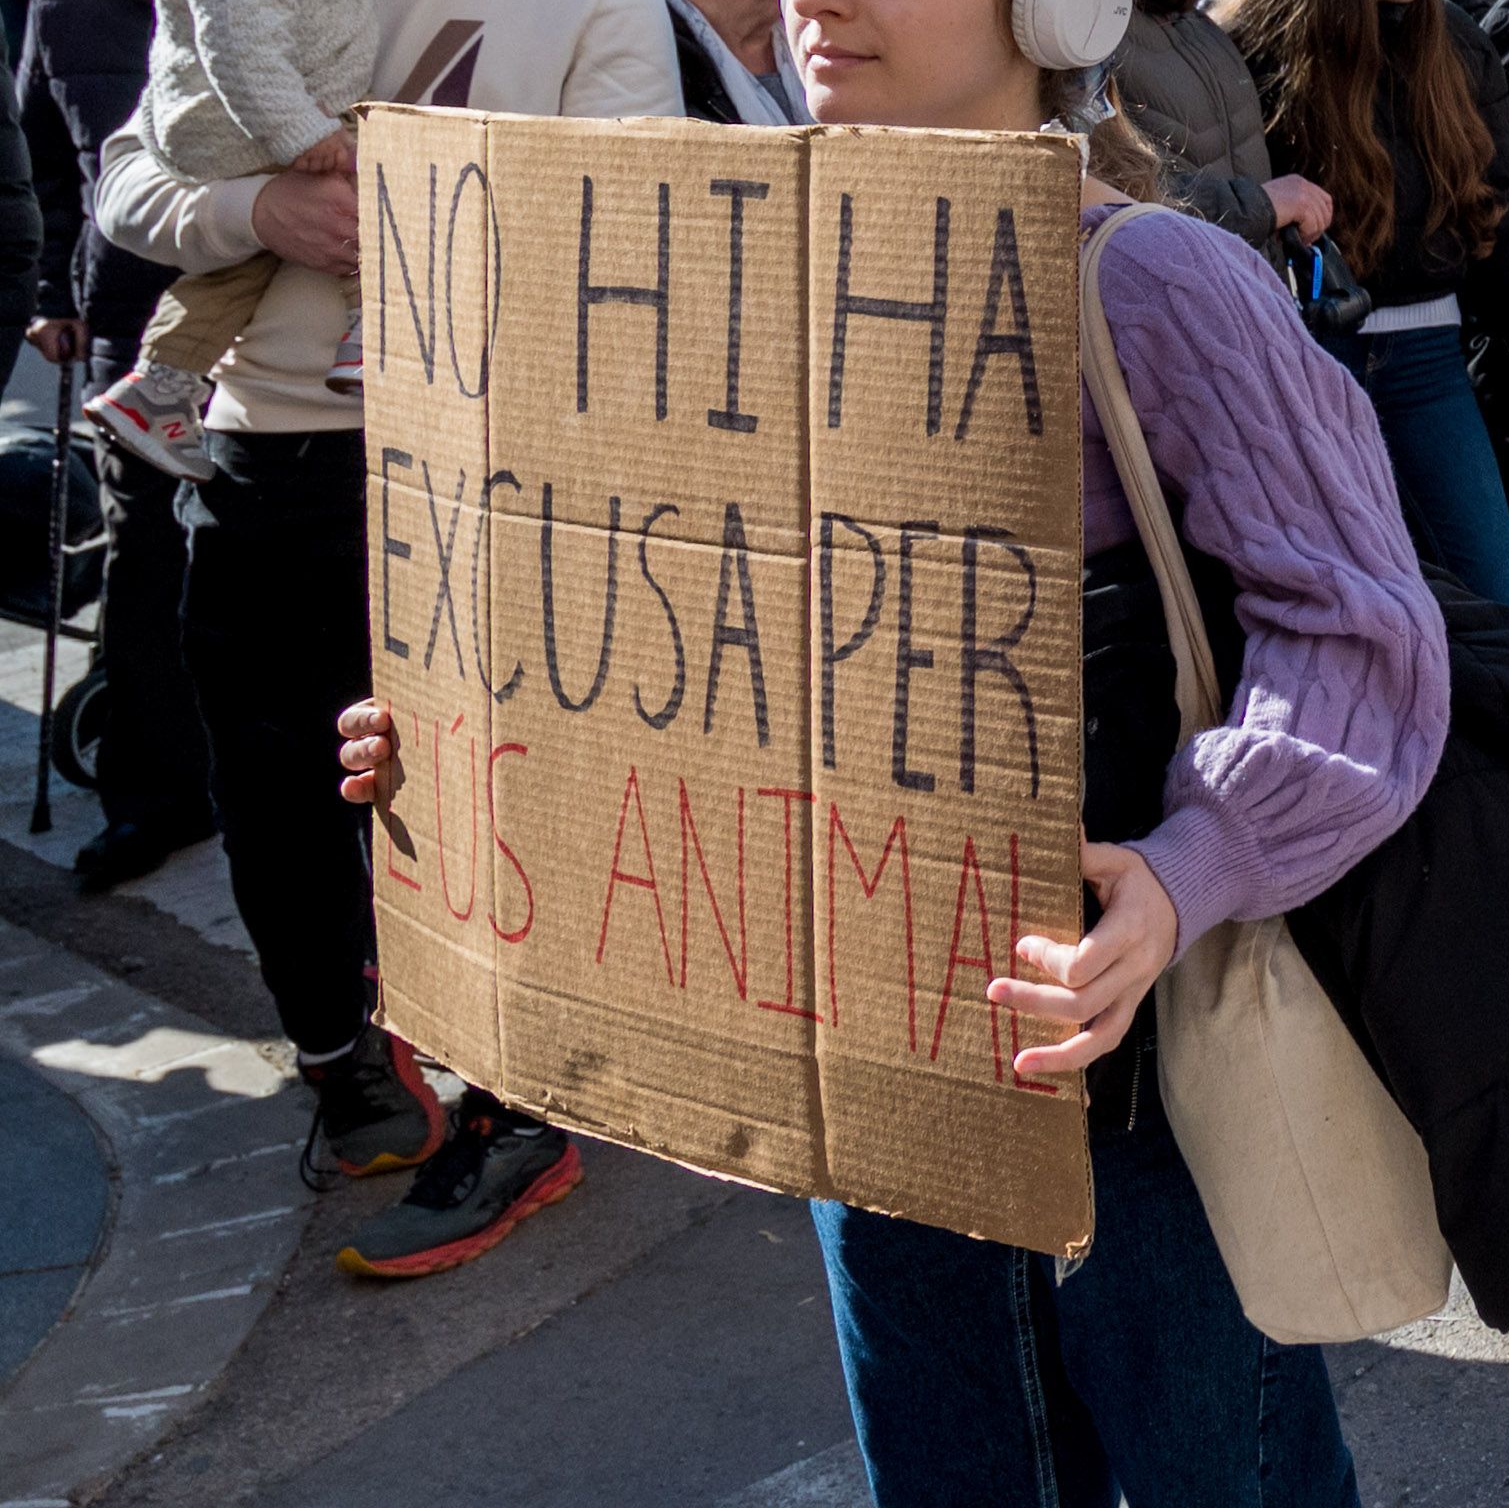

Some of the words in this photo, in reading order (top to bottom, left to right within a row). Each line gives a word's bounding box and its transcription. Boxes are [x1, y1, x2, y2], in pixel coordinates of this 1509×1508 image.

[1113, 6, 1128, 16] JVC
[376, 161, 502, 400] NO
[575, 174, 772, 434] HI
[827, 192, 1044, 441] HA
[381, 446, 771, 749] EXCUSA
[820, 510, 1041, 800] PER
[594, 765, 1060, 1096] ANIMAL
